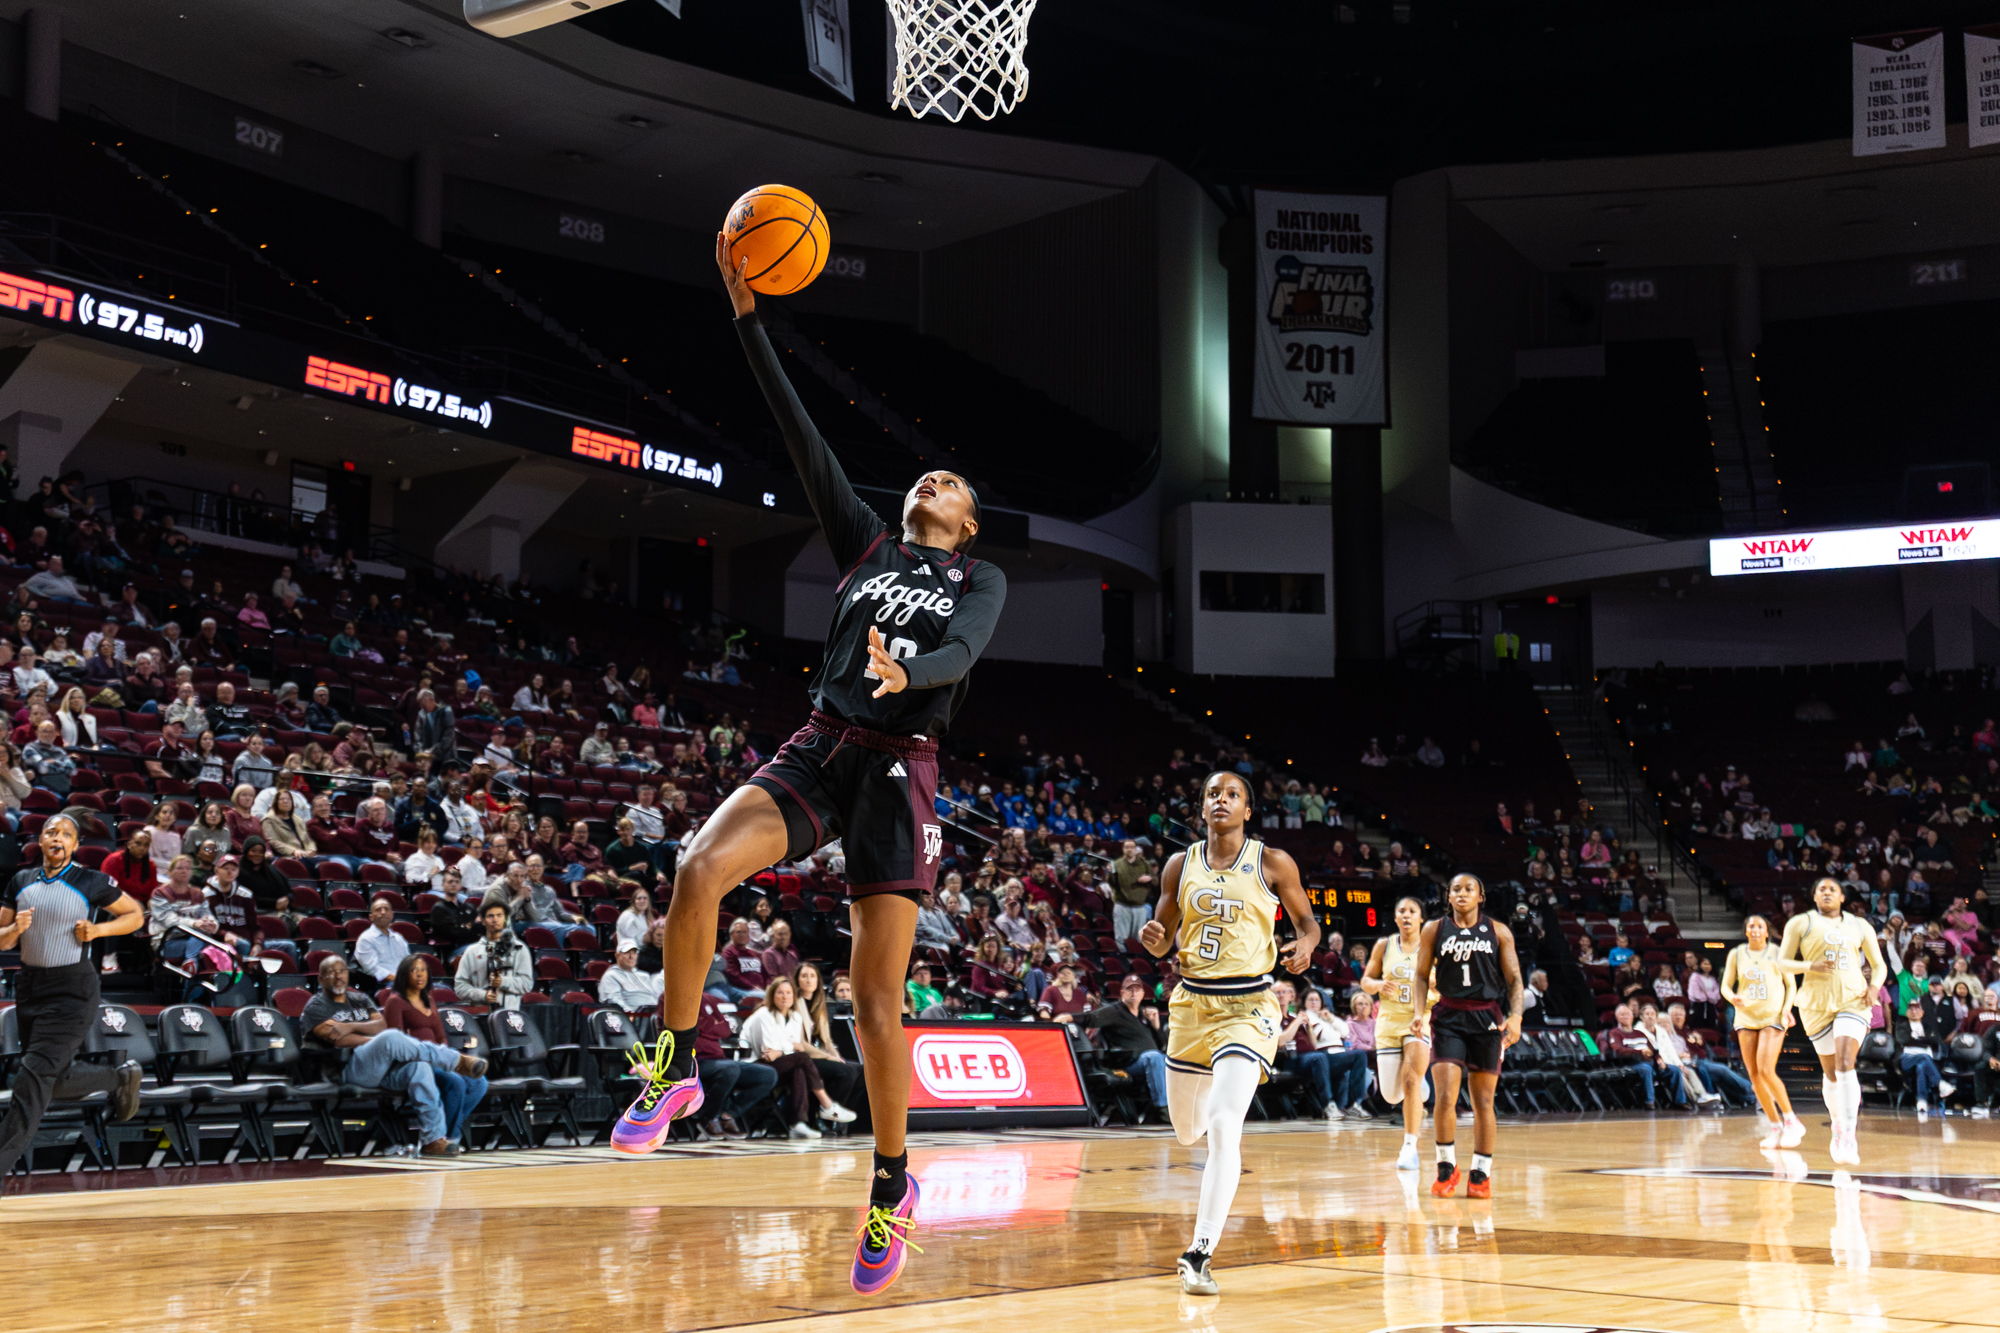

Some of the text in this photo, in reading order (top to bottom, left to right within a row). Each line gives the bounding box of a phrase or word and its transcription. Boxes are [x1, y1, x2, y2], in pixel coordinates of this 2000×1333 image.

[235, 121, 284, 154] 207
[559, 216, 605, 243] 208
[1277, 210, 1361, 232] NATIONAL
[1265, 231, 1373, 254] CHAMPIONS
[1299, 265, 1368, 294] FINAL
[1916, 262, 1959, 284] 211
[1609, 280, 1656, 300] 210
[1286, 342, 1354, 375] 2011
[305, 355, 391, 405] ESPN
[571, 426, 641, 469] ESPN
[1743, 527, 1974, 556] WTAW WTAW
[1946, 544, 1977, 556] 1620
[1787, 555, 1816, 567] 1620
[852, 571, 955, 627] Aggie
[1199, 923, 1223, 962] 5
[1441, 935, 1493, 962] Aggies
[1461, 963, 1472, 987] 1
[1748, 984, 1767, 1001] 33
